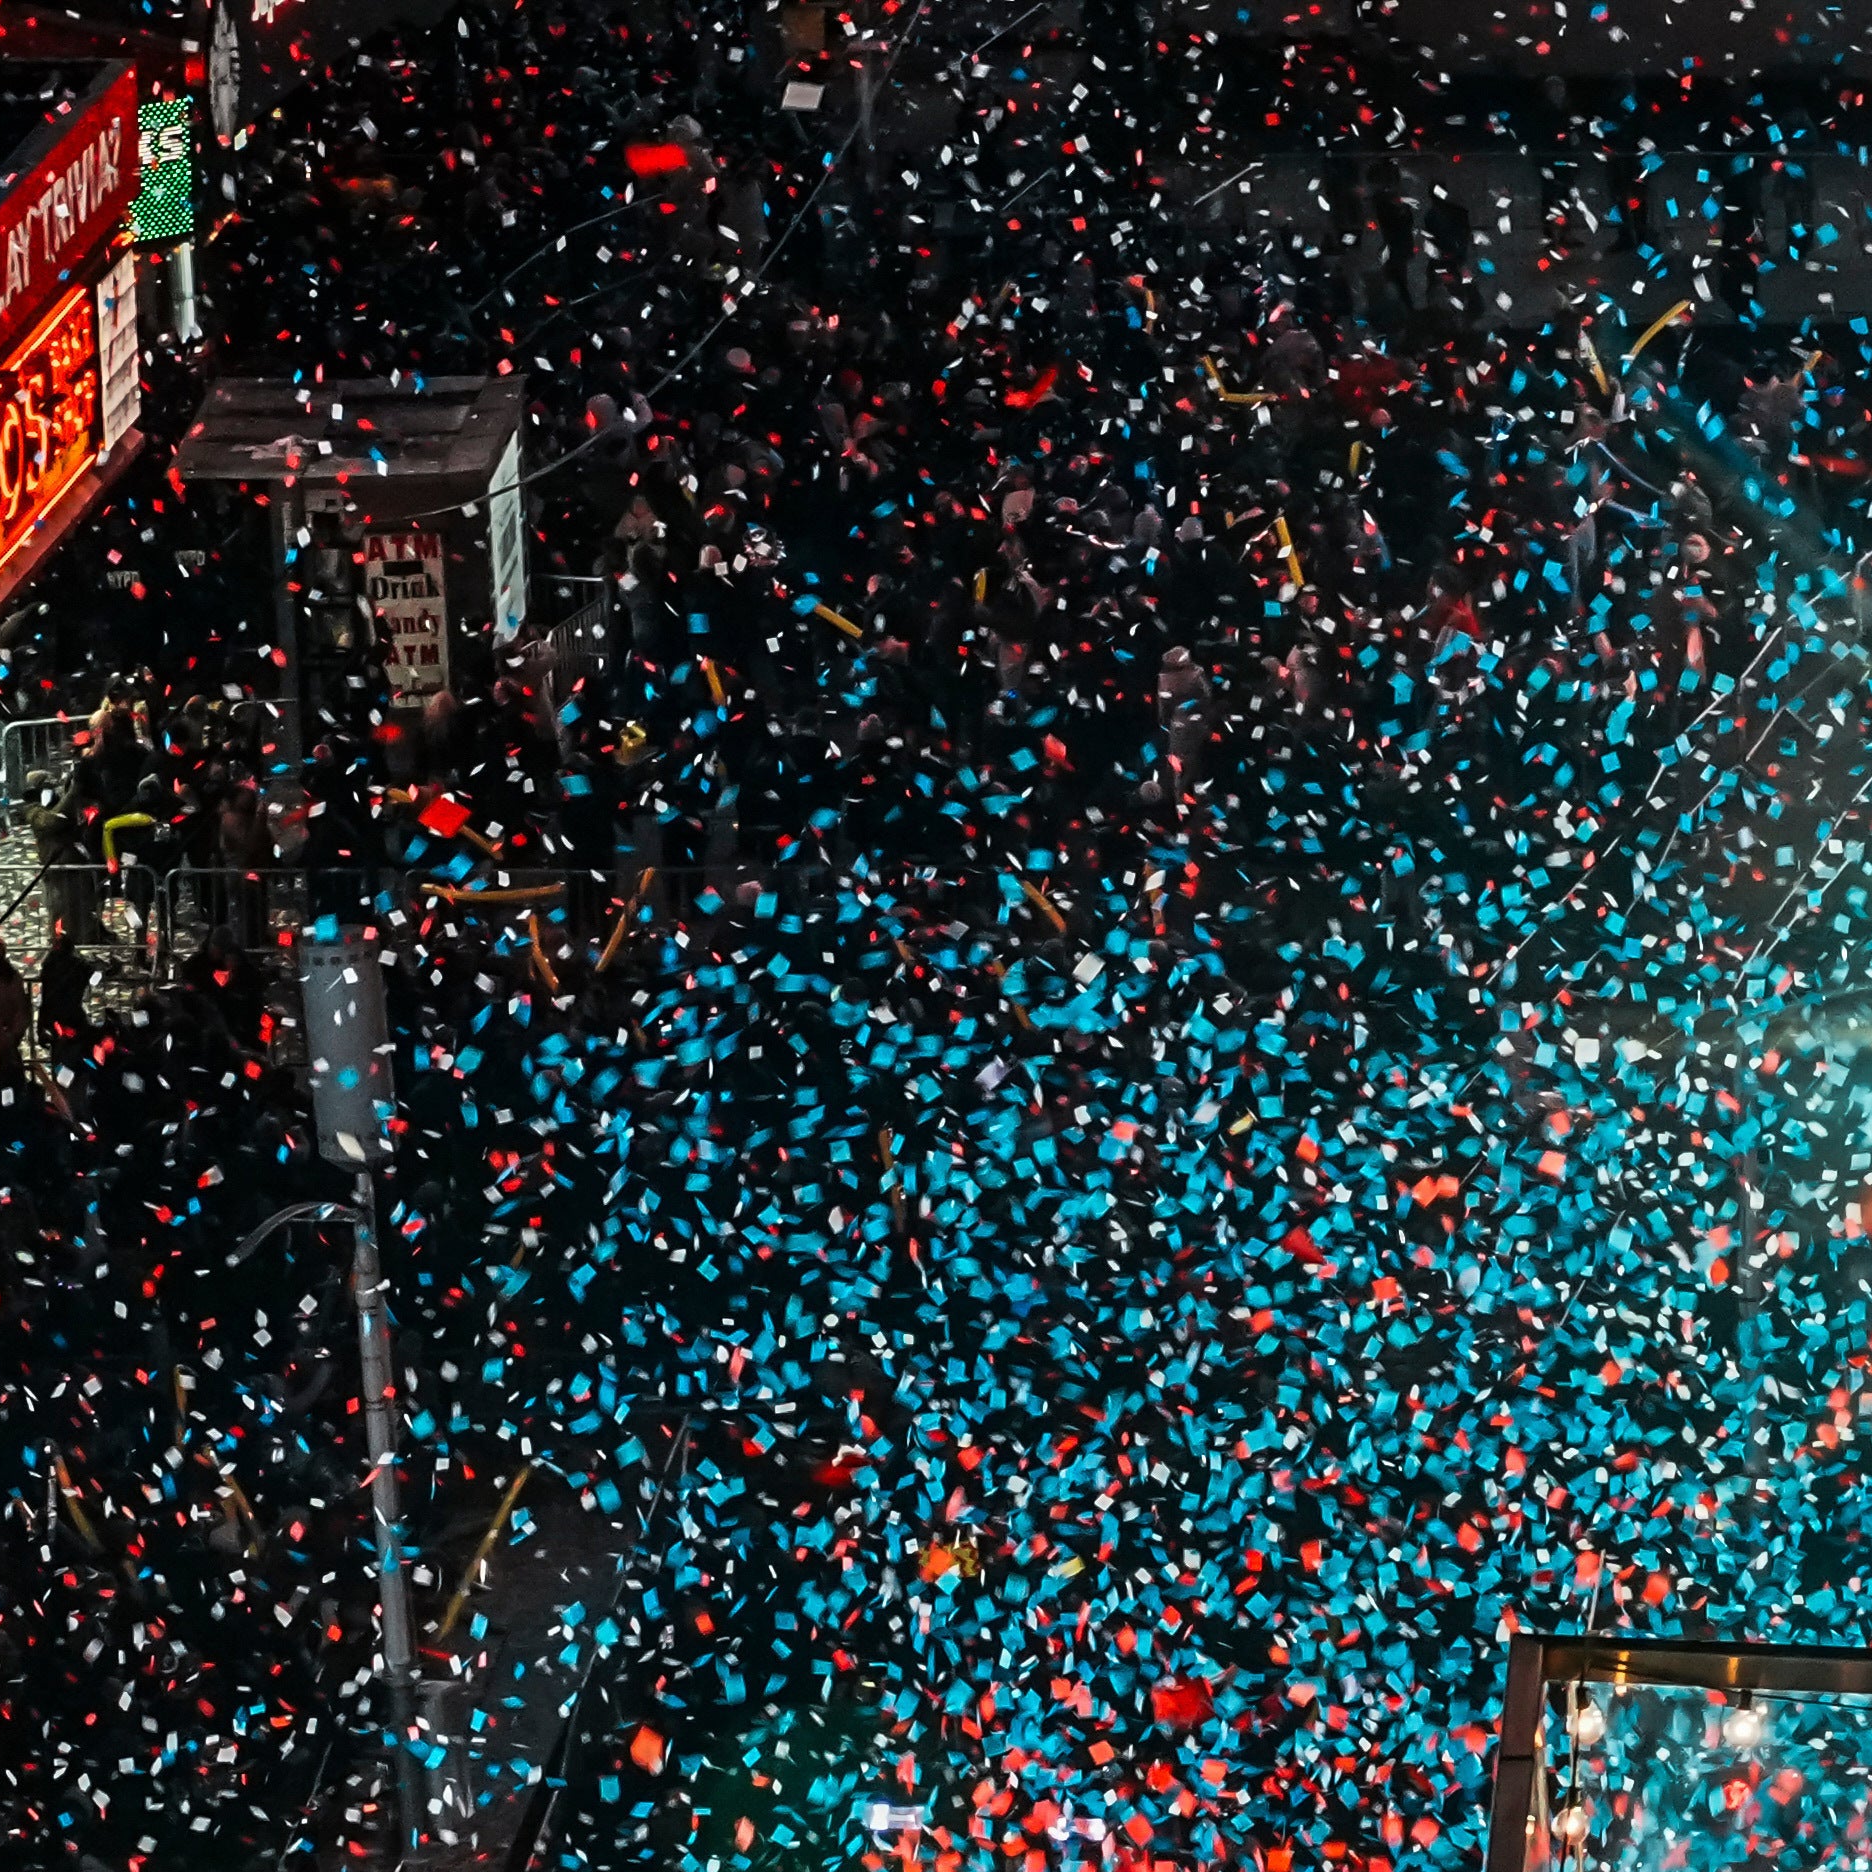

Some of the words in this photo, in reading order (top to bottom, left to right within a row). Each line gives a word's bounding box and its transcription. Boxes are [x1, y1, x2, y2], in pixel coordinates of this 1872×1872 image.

[368, 534, 440, 561] ATM
[387, 607, 441, 637] andy
[386, 643, 440, 666] ATM
